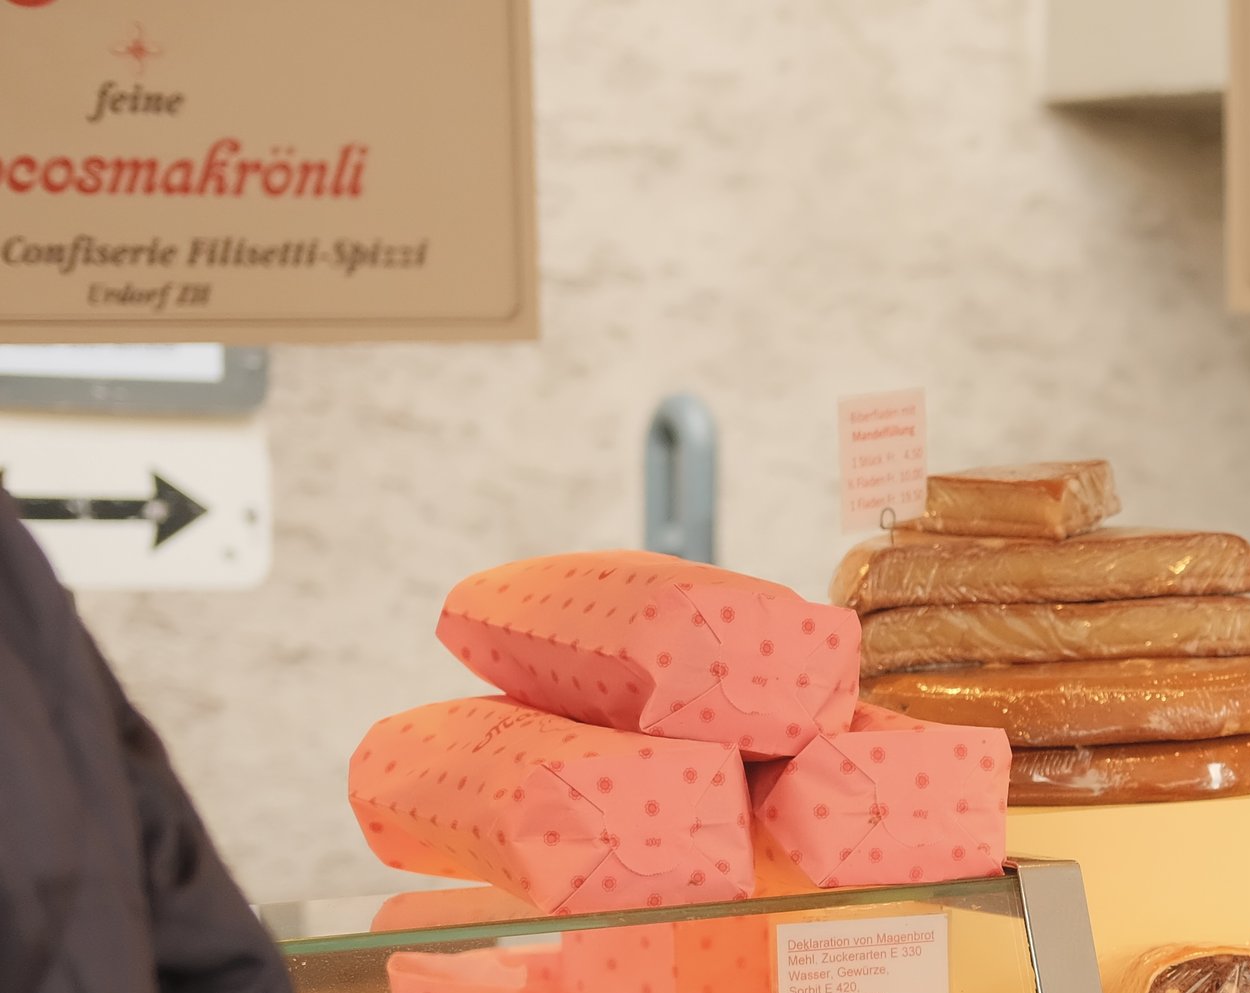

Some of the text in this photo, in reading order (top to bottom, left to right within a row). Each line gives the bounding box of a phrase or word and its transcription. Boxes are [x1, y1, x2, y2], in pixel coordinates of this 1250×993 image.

[87, 81, 186, 123] feine
[0, 138, 371, 200] cosmakrönli
[1, 233, 429, 275] Confiserie Filisetti-Spizzi
[86, 281, 170, 311] Urdorf
[787, 930, 934, 951] Deklaration von Magenbrot
[821, 951, 887, 964] Zuckerarten
[890, 948, 898, 959] E
[902, 946, 922, 958] 330
